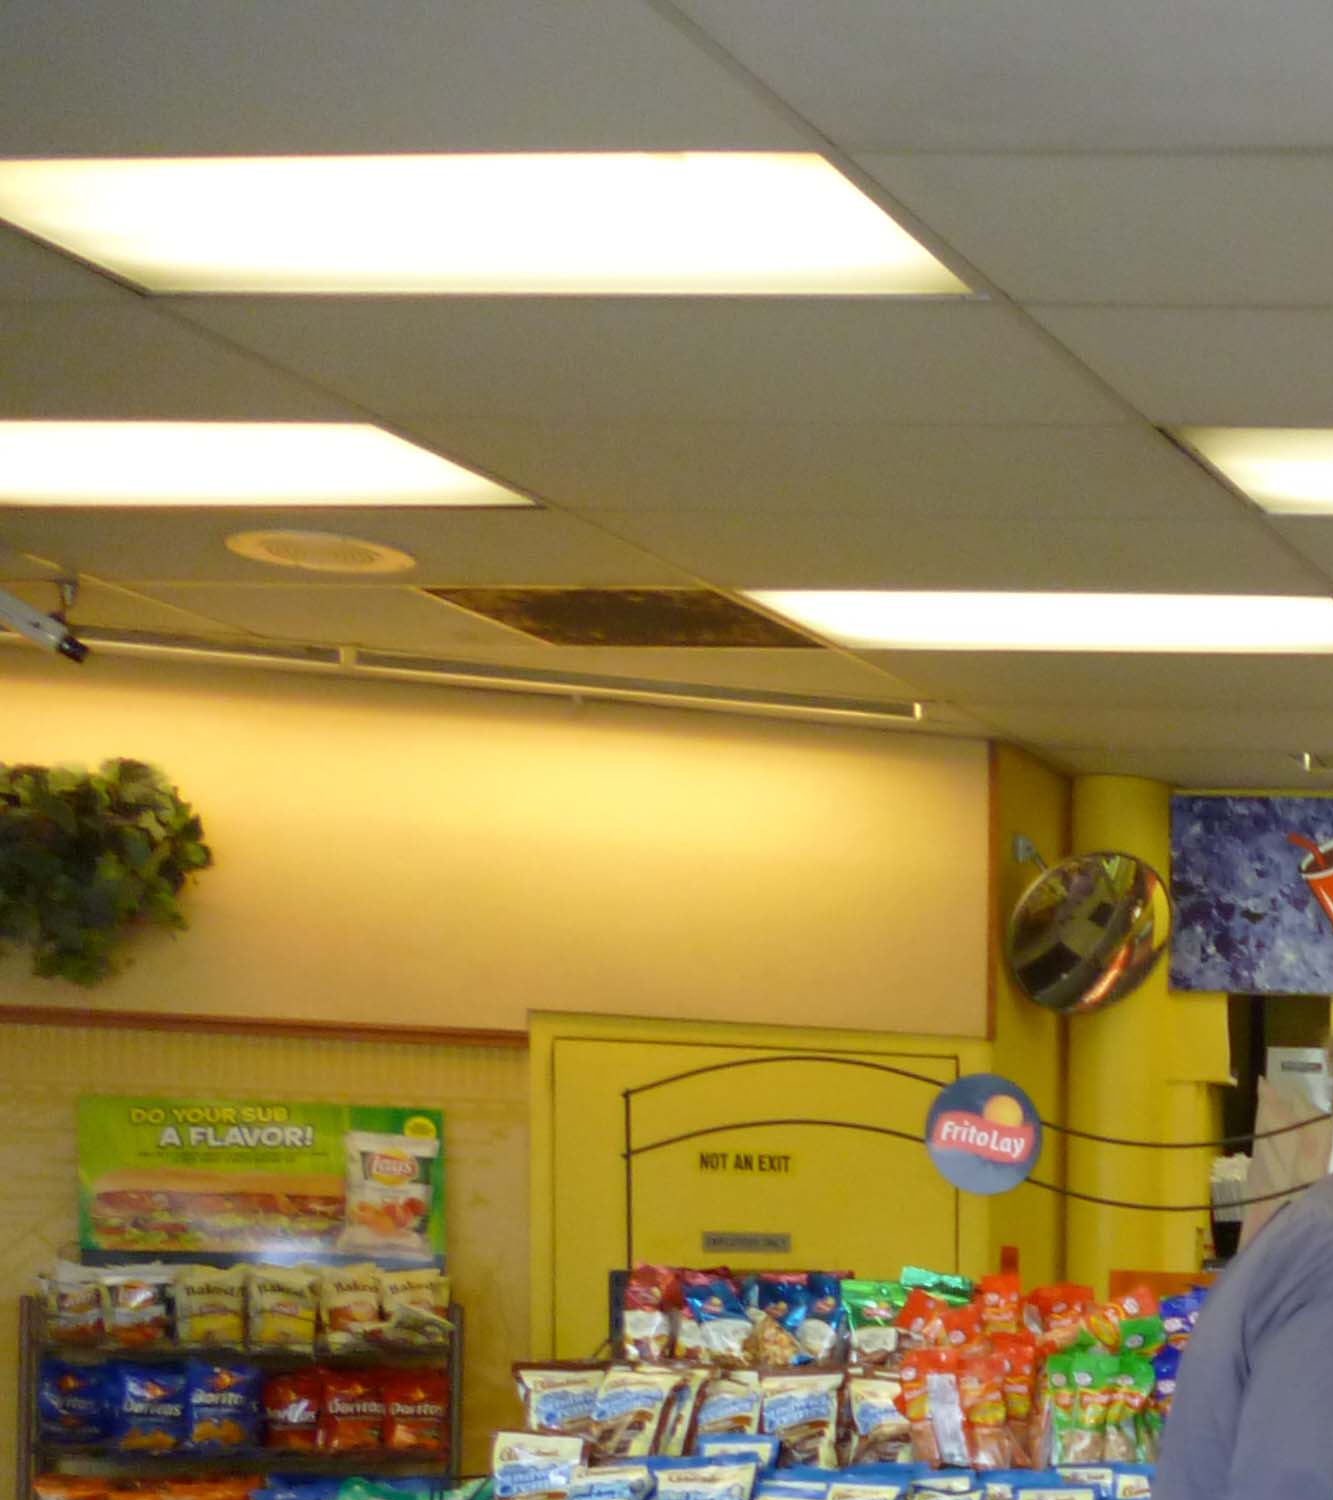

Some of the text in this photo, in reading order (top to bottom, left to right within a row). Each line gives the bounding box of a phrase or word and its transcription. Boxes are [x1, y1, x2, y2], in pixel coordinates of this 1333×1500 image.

[130, 1106, 290, 1124] DO YOUR SUB
[159, 1126, 315, 1148] A FLAVOR!
[699, 1152, 792, 1173] NOT AN EXIT
